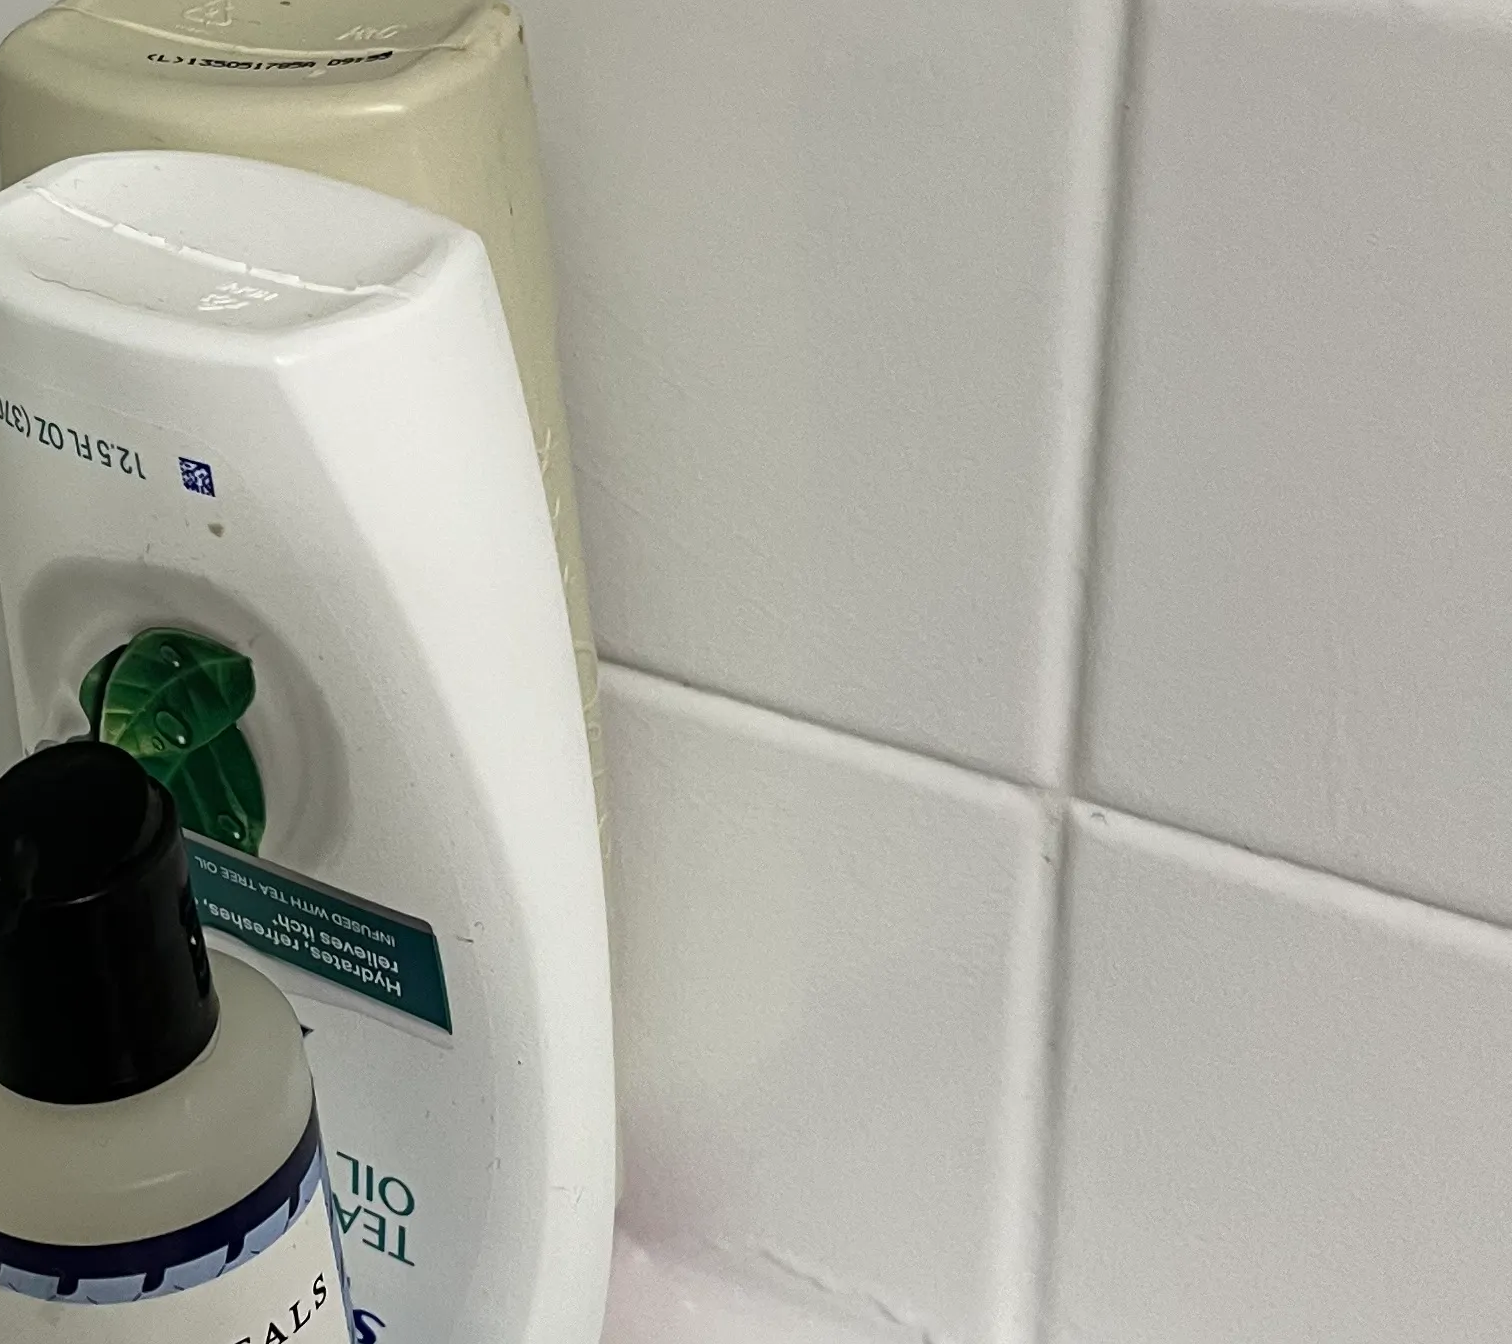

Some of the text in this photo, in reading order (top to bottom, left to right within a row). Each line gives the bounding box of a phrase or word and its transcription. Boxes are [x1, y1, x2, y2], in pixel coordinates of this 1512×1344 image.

[33, 415, 64, 450] OZ
[66, 428, 93, 461] FL
[96, 439, 146, 480] 12.5
[194, 855, 397, 948] INFUSED WITH TEA TREE OIL
[202, 898, 402, 998] Hydrates, refreshes,
[319, 930, 399, 973] relieves
[336, 1151, 415, 1217] OIL
[332, 1191, 416, 1267] TEA
